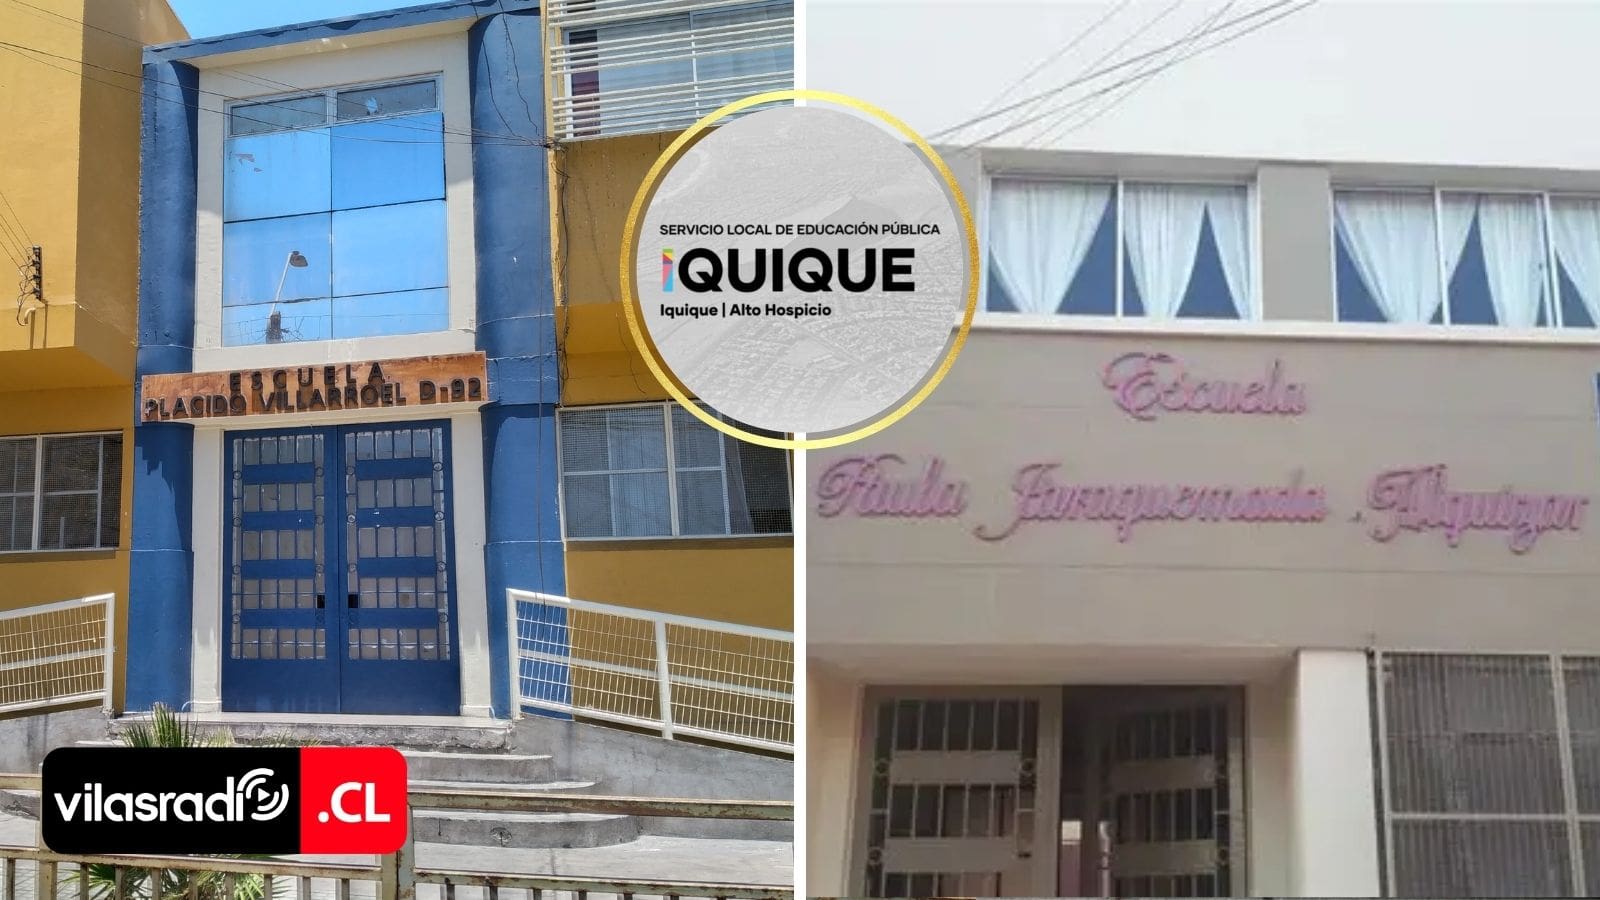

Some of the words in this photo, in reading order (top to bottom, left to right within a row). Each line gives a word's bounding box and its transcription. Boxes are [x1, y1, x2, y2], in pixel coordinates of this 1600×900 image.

[143, 393, 248, 420] PLACIDO
[258, 381, 407, 412] VILLARROEL
[419, 376, 482, 403] D-92
[229, 361, 386, 393] ESCUELA
[1102, 352, 1306, 421] Escuela
